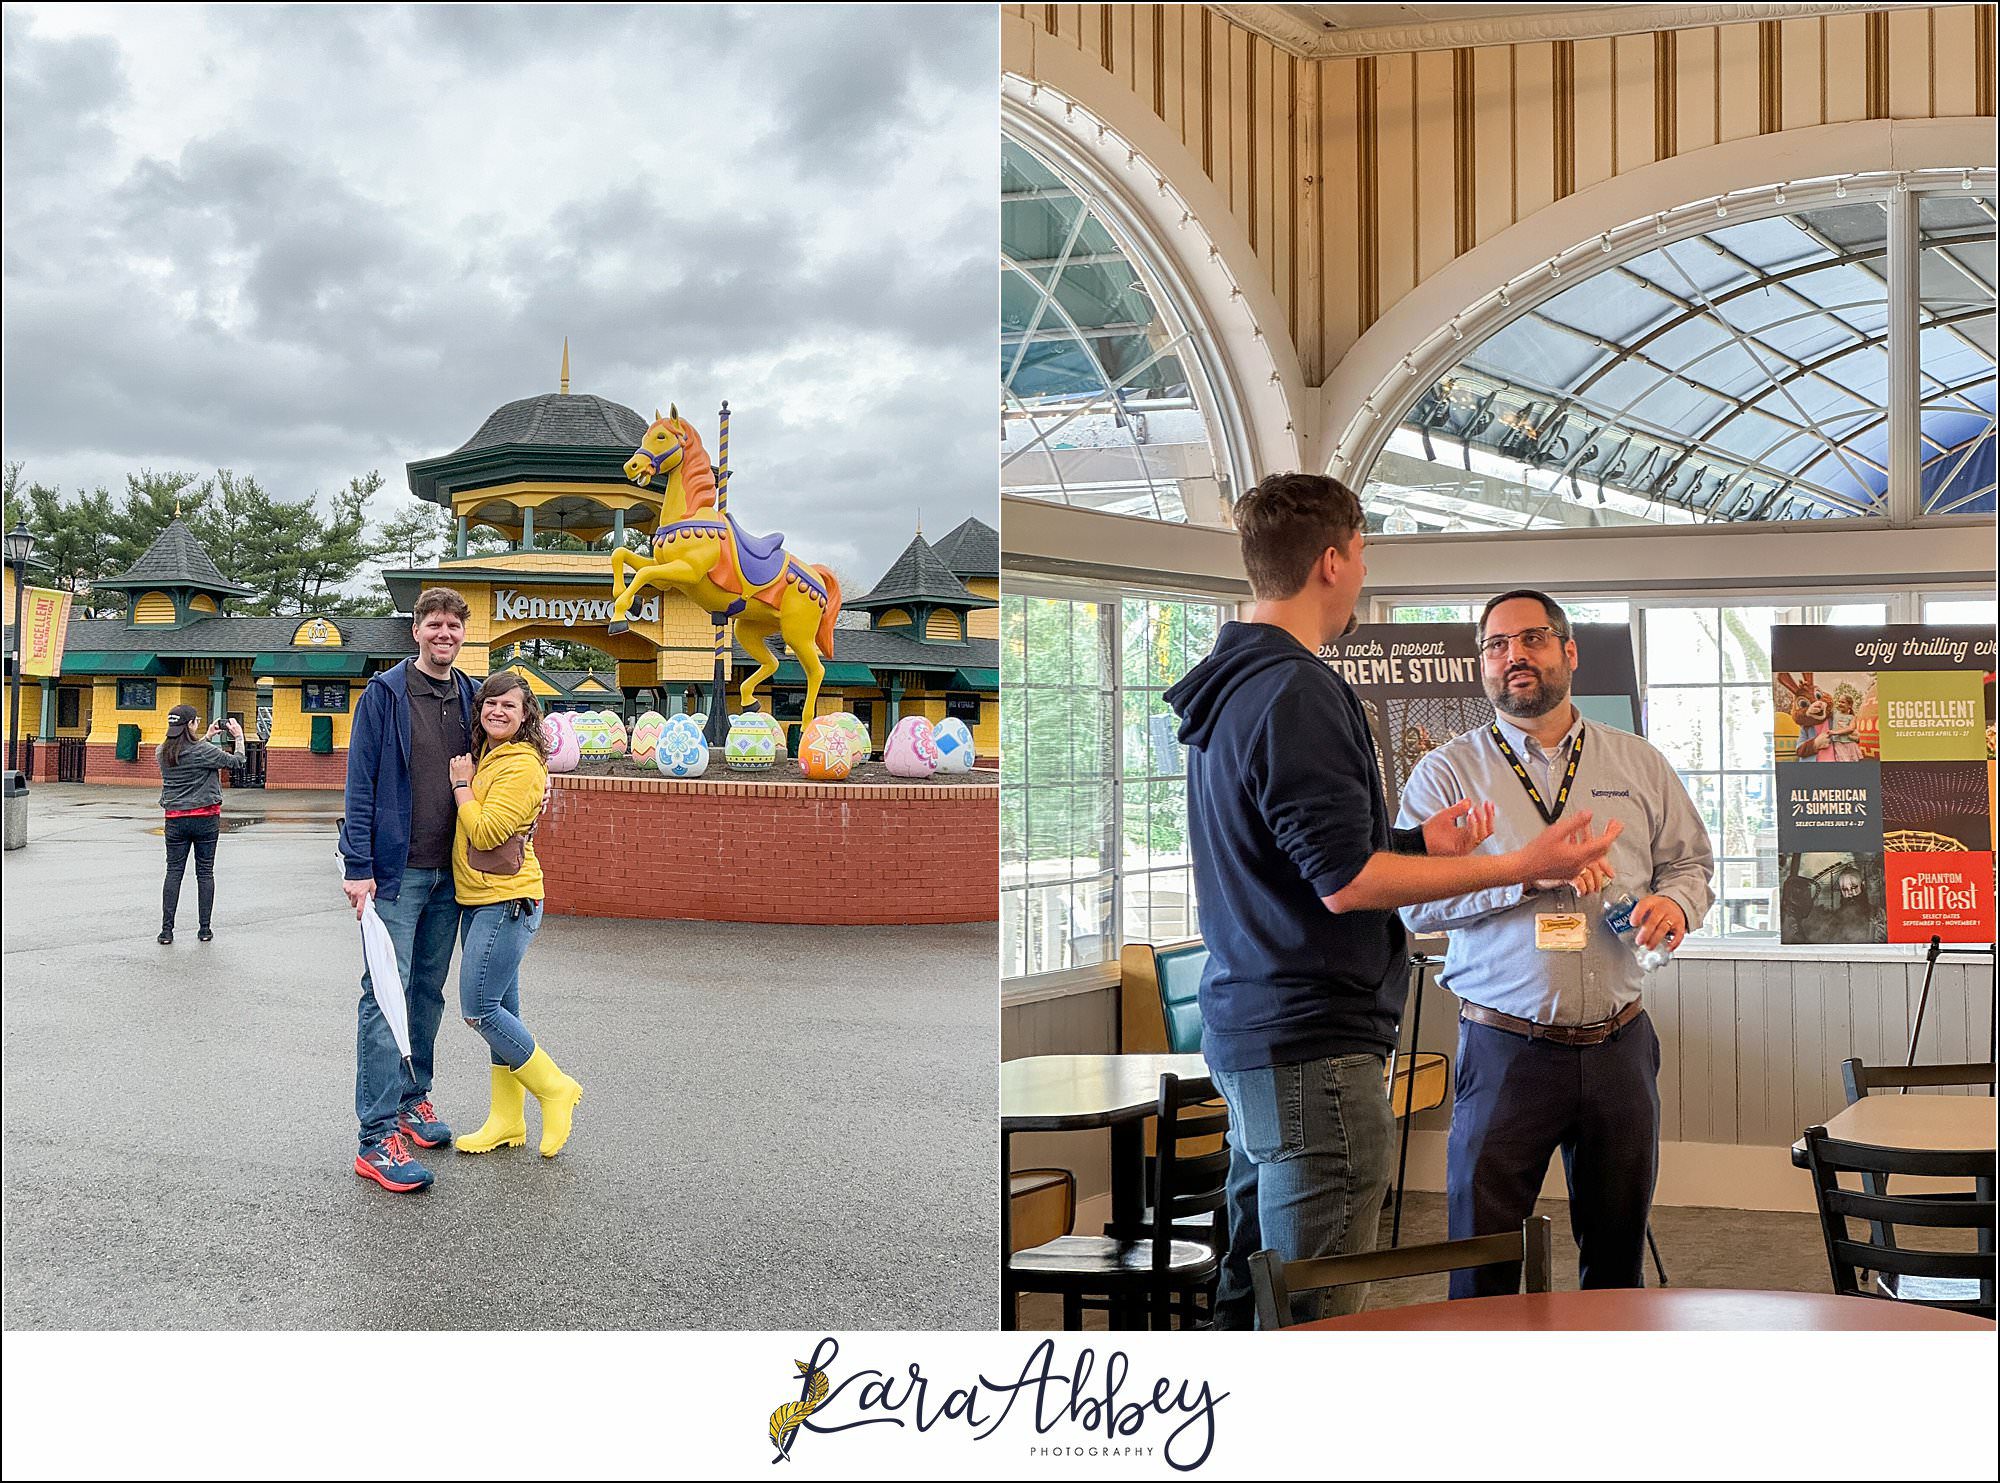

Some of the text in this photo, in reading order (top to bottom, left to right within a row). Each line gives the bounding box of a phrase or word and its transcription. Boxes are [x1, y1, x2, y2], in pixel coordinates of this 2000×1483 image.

[493, 589, 661, 627] Kennywd
[33, 598, 49, 658] EGGCELLENT
[42, 600, 55, 658] CELEBRATION
[1317, 640, 1446, 661] ess nocks present
[1855, 638, 1898, 665] enjoy
[1902, 637, 1968, 663] thrilling
[1323, 657, 1476, 685] TREME STUNT
[1888, 700, 1976, 719] EGGCELLENT
[1888, 719, 1975, 728] CELEBRATION
[1790, 789, 1867, 801] ALL AMERICAN
[1806, 802, 1852, 815] SUMMER
[1917, 873, 1962, 886] PHANTOM
